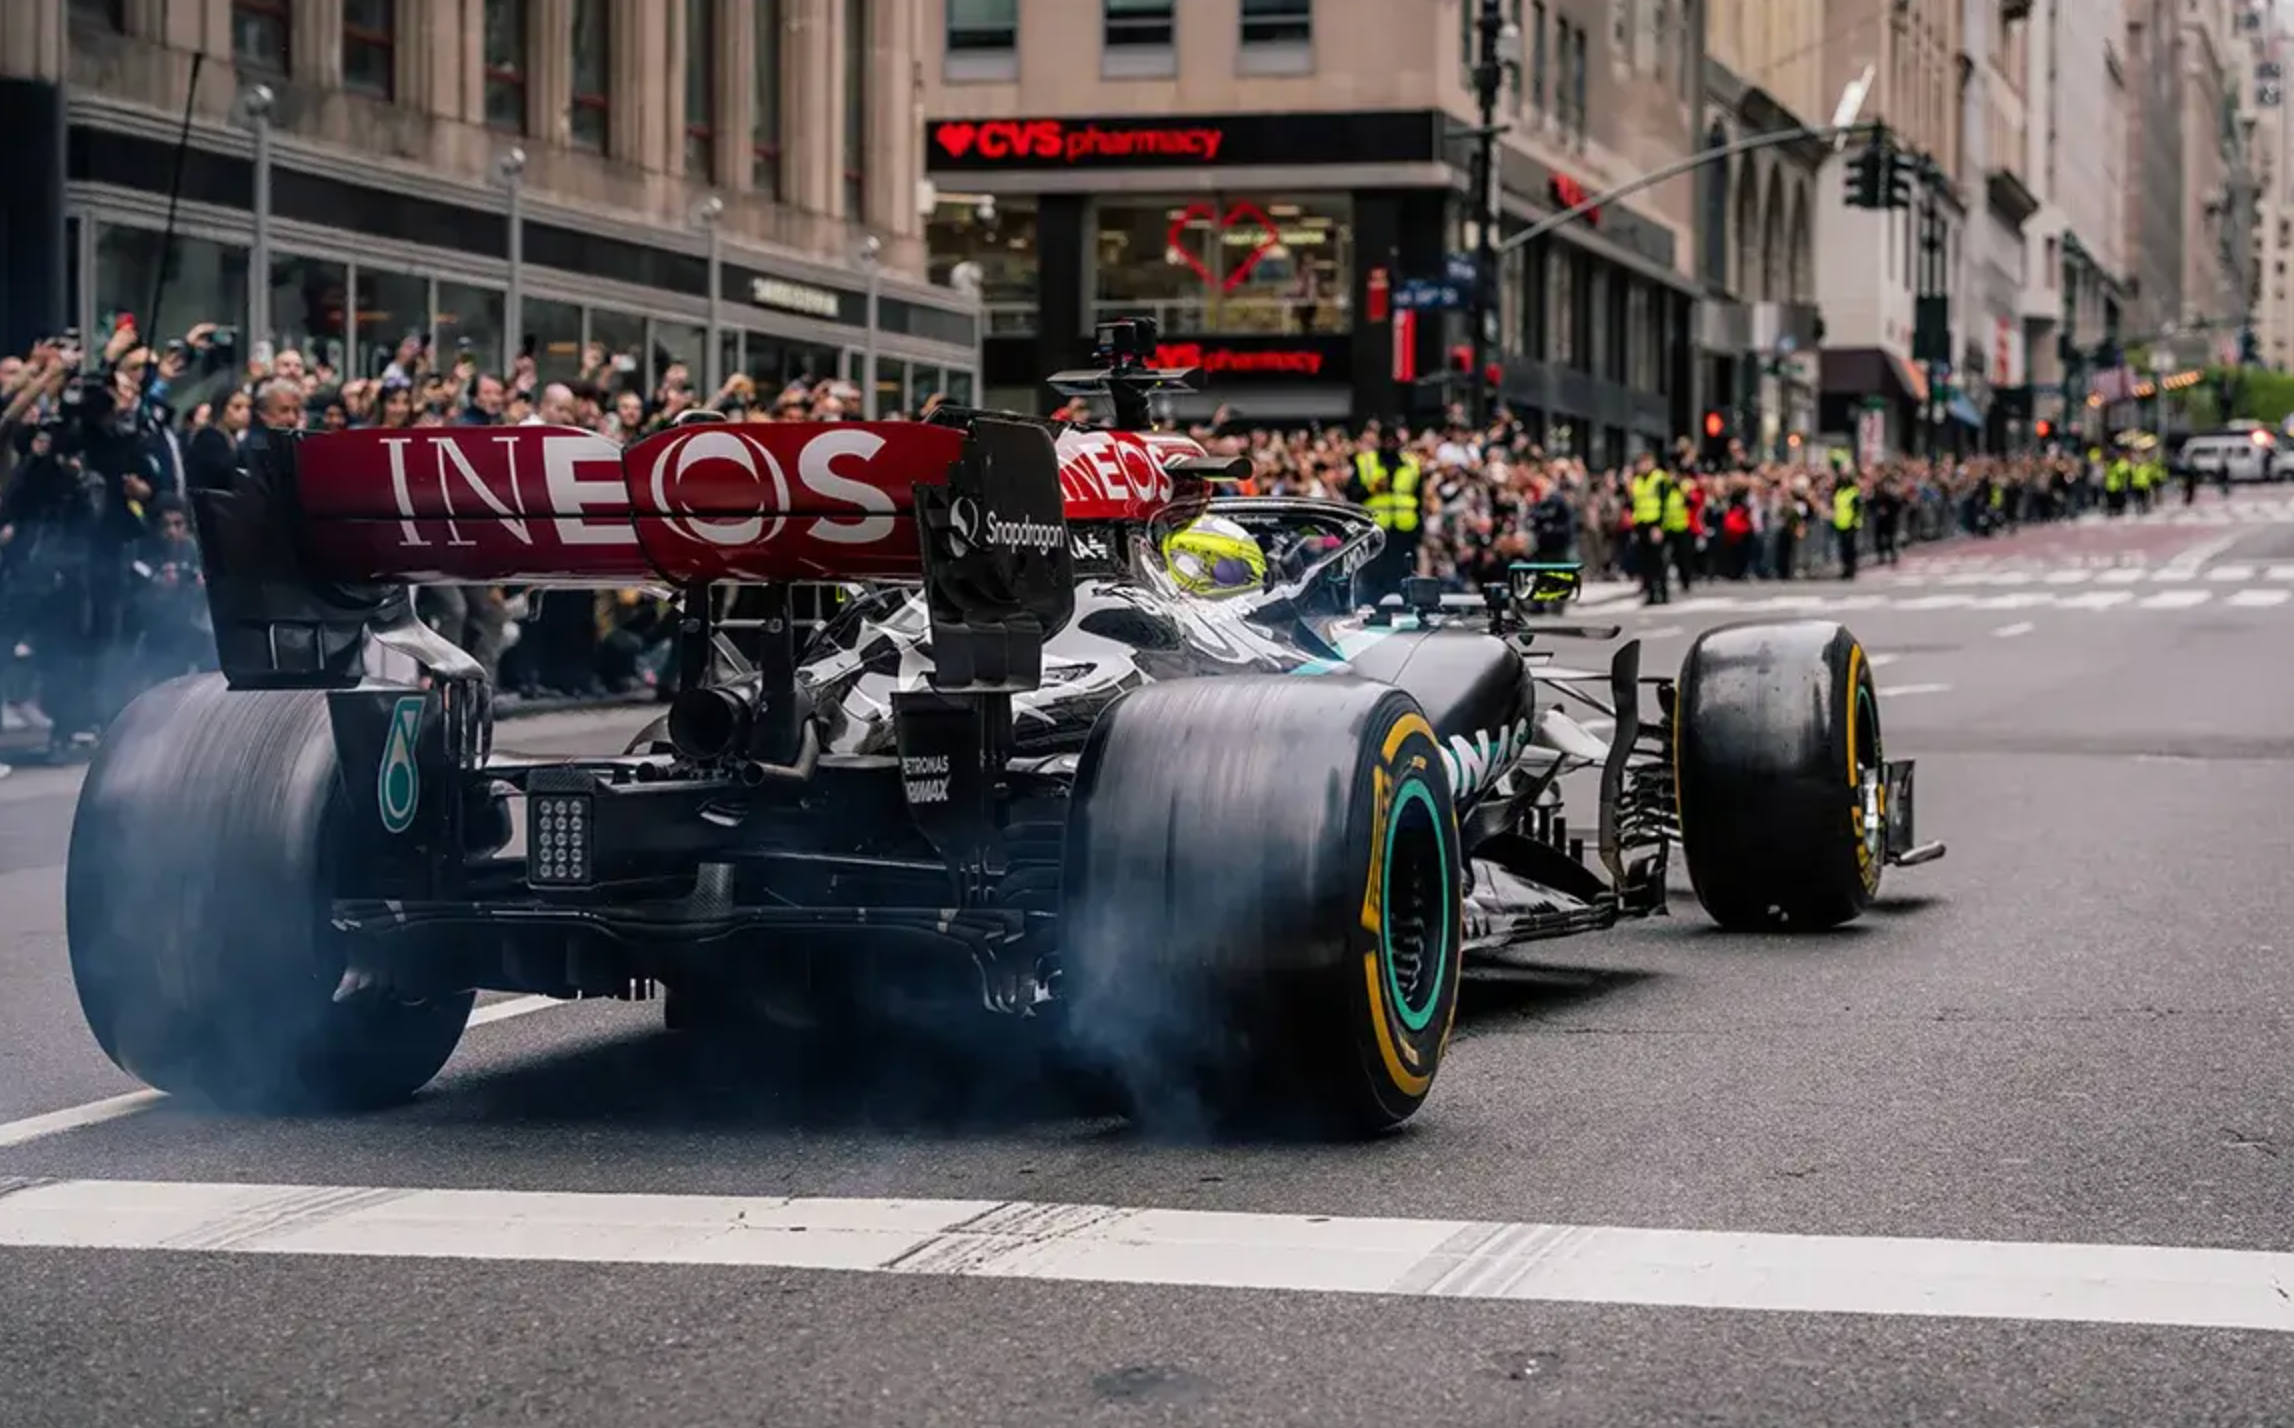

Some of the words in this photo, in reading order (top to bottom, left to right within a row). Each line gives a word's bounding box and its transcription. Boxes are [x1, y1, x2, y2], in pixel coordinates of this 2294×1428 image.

[976, 120, 1063, 158] CVS
[1066, 126, 1222, 161] pharmacy
[1203, 349, 1323, 374] pharmacy
[379, 428, 898, 546] INEOS
[985, 510, 1065, 556] Snapdragon
